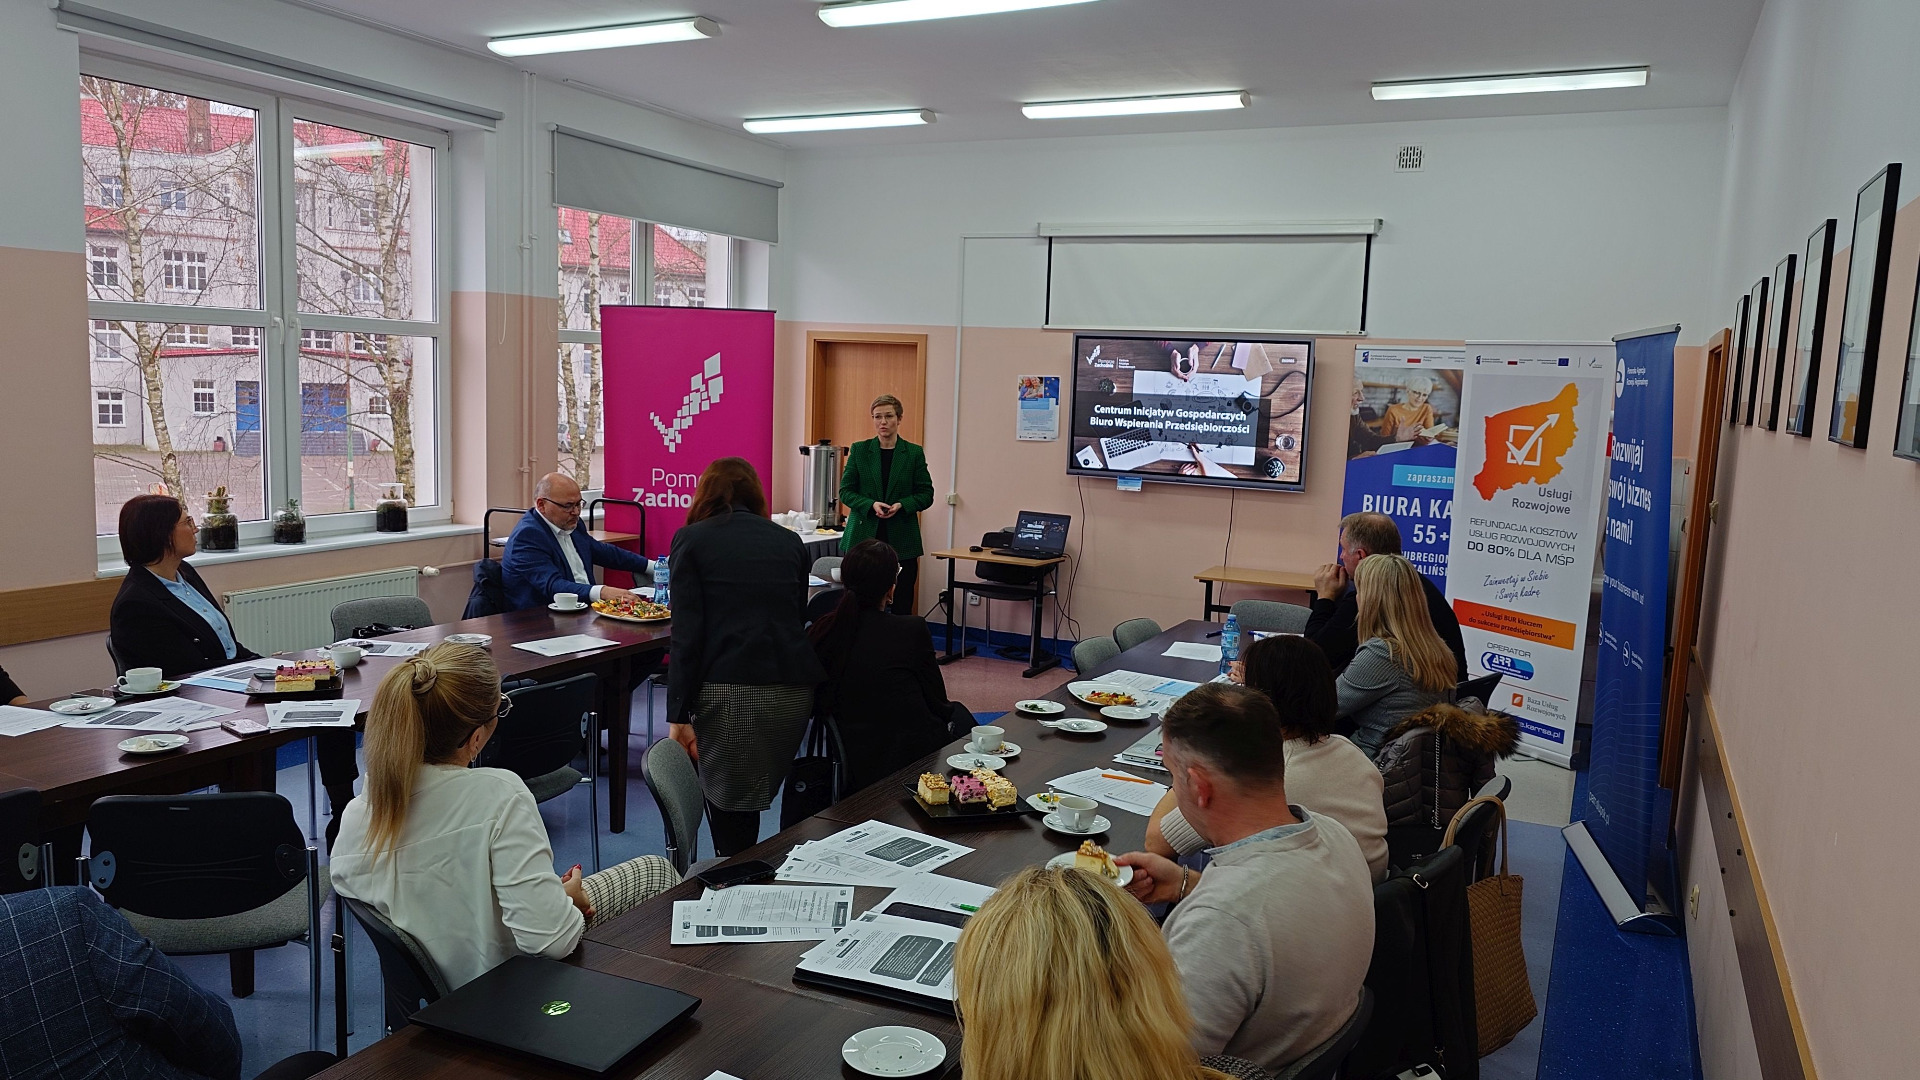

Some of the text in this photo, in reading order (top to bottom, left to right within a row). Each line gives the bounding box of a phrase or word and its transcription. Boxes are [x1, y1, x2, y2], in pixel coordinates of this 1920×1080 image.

[1094, 404, 1247, 423] Centrum Inicjatyw Gospodarczych
[1090, 416, 1250, 434] Biuro Wspierania Przedsiębiorczości
[1611, 435, 1645, 473] Rozwijaj
[652, 468, 701, 488] Pom
[1407, 473, 1454, 484] zapraszam
[632, 488, 697, 508] Zacho
[1538, 487, 1572, 502] Usługi
[1627, 478, 1651, 512] biznes
[1362, 494, 1454, 519] BIURA KA
[1511, 498, 1571, 514] Rozwojowe
[1470, 517, 1578, 540] REFUNDACJA KOSZTÓW
[1610, 518, 1633, 546] nami!
[1469, 529, 1576, 552] USŁUG ROZWOJOWYCH
[1467, 541, 1575, 566] DO 80% DLA MŚP
[1527, 569, 1549, 582] Siebie
[1477, 619, 1500, 629] sukcesu
[1503, 615, 1517, 624] BUR
[1517, 618, 1543, 629] kluczem
[1486, 642, 1532, 659] OPERATOR
[1492, 655, 1512, 668] ARR
[1526, 705, 1567, 721] Rozwojowych
[1527, 697, 1559, 712] Baza Usług
